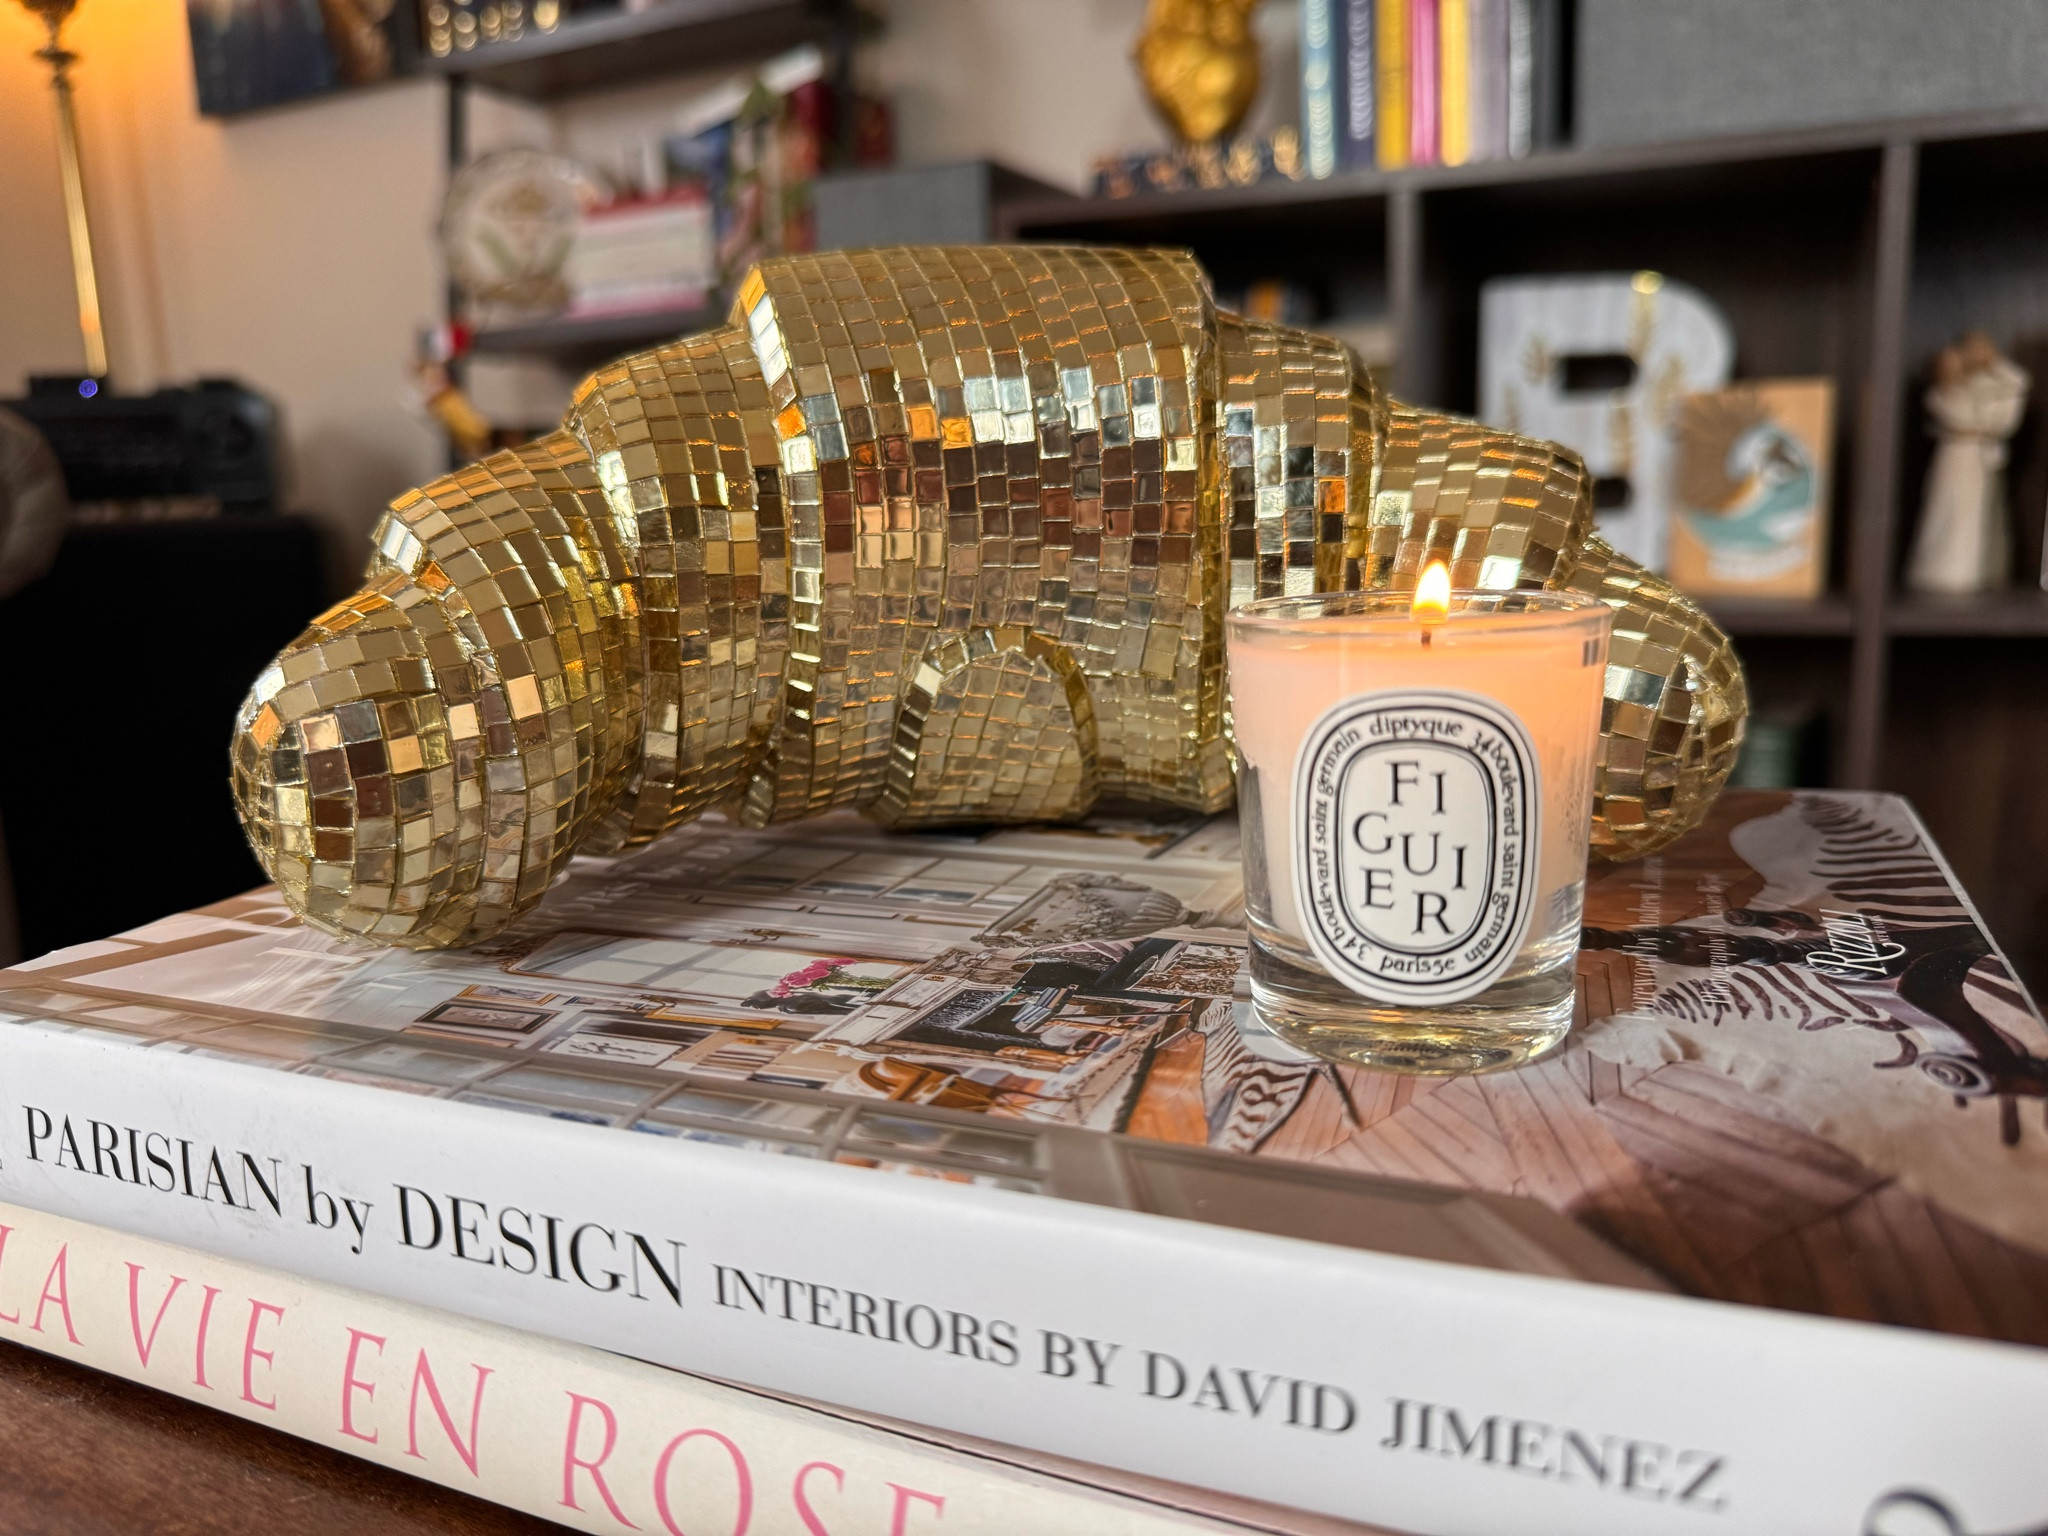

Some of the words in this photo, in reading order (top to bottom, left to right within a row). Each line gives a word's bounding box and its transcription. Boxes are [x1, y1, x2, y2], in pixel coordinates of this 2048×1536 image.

[1368, 713, 1463, 738] diptyque
[1467, 731, 1491, 755] 34
[1317, 730, 1361, 798] germain
[1489, 744, 1519, 836] boulevard
[1310, 800, 1328, 844] saint
[1311, 848, 1346, 942] boulevard
[1502, 842, 1520, 887] saint
[1344, 934, 1373, 962] 34
[1465, 891, 1511, 964] germain
[1806, 908, 1906, 975] RIZZOLI
[1615, 953, 1658, 1021] Foreword
[1699, 936, 1738, 1004] Photography
[22, 1104, 283, 1219] PARISIAN
[301, 1164, 375, 1255] by
[392, 1183, 687, 1308] DESIGN
[711, 1263, 1021, 1368] INTERIORS
[1038, 1328, 1122, 1387] BY
[1140, 1350, 1360, 1436] DAVID
[1381, 1398, 1731, 1512] JIMENEZ
[0, 1224, 84, 1347] LA
[125, 1261, 286, 1411] VIE
[337, 1326, 496, 1479] EN
